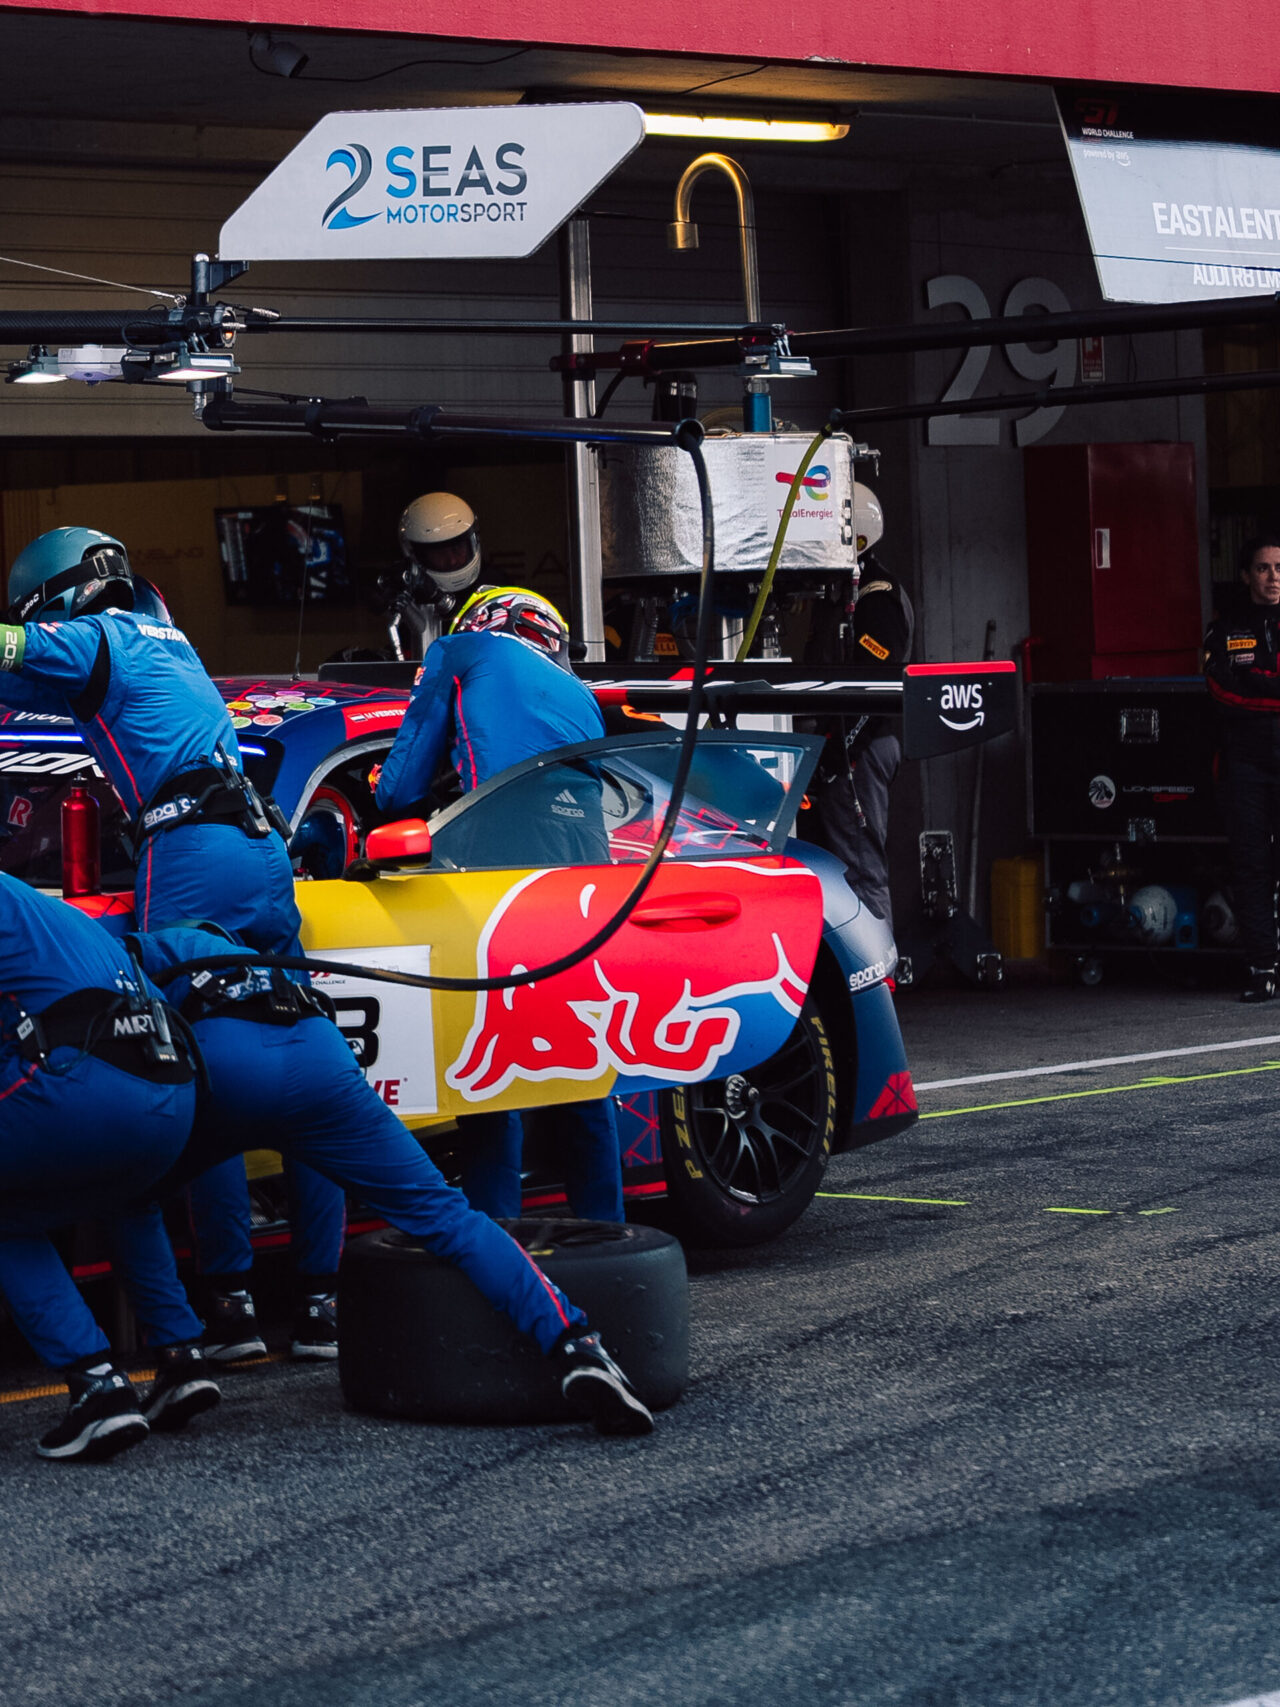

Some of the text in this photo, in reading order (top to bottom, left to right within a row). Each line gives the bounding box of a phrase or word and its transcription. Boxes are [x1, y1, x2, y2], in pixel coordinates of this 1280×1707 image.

[1082, 127, 1134, 139] WORLD CHALLENGE
[386, 143, 528, 199] SEAS
[386, 202, 528, 225] MOTORSPORT
[1256, 268, 1280, 289] LM
[926, 275, 1078, 448] 29
[777, 508, 833, 520] TalEnergies
[940, 682, 984, 713] aws
[849, 961, 886, 991] sparco
[810, 1016, 837, 1154] PIRELLI
